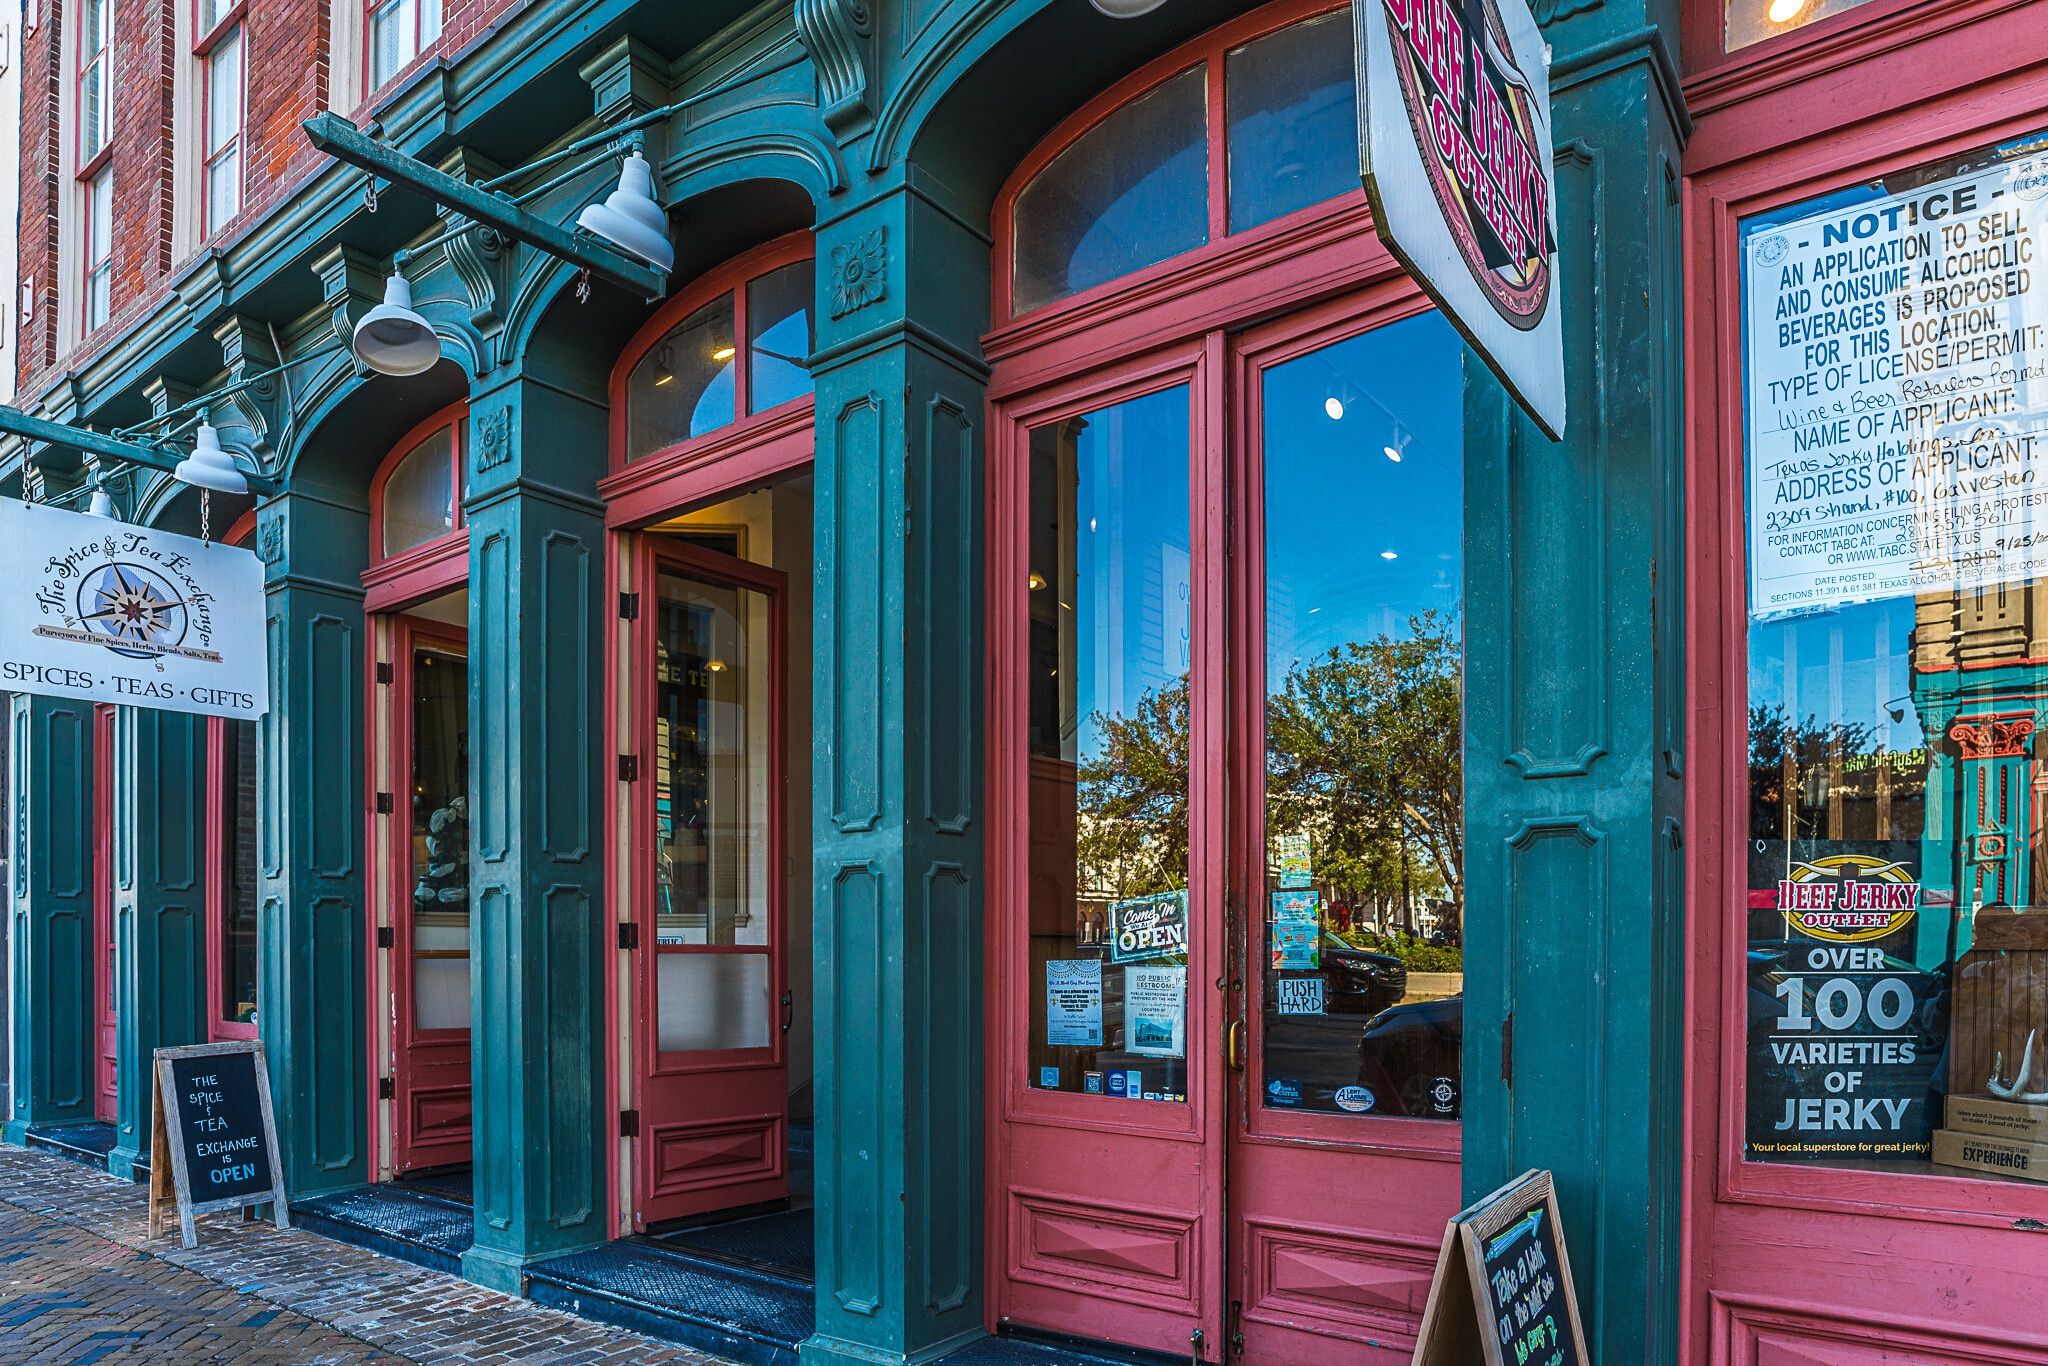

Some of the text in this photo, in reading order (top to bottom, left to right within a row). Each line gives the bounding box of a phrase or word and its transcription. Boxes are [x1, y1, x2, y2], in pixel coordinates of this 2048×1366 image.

[1470, 37, 1547, 265] JERKY
[1432, 93, 1526, 276] OUTLET
[1823, 184, 1977, 248] NOTICE
[1780, 208, 2027, 290] AN APPLICATION TO SELL
[1775, 237, 2033, 320] AND CONSUME ALCOHOLIC
[1779, 268, 2031, 348] BEVERAGES IS PROPOSED
[1805, 306, 2000, 370] FOR THIS LOCATION.
[1768, 325, 2044, 404] TYPE OF LICENSE/PERMIT:
[1778, 409, 1827, 431] Wine
[1850, 390, 1896, 413] Beer
[1793, 387, 2016, 453] NAME OF APPLICANT:
[1764, 457, 1821, 479] Texas
[1823, 448, 1873, 472] Jerky
[1775, 435, 2039, 504] ADDRESS OF APPLICANT:
[1766, 506, 1811, 531] 2309
[1933, 468, 2035, 500] Galveston
[1768, 492, 2048, 547] FOR INFORMATION CONCERNING FILING A PROTEST
[44, 542, 100, 579] Spice
[122, 532, 163, 561] Tea
[1779, 535, 1875, 558] CONTACT TABC AT:
[1827, 531, 1981, 565] OR WWW.TABC.STATE.TX.US
[1770, 558, 2047, 603] SECTIONS 11.391 & 61.381 TEXAS ALCOHOLIC BEVERAGE CODE
[1815, 572, 1877, 586] DATE POSTED:
[36, 580, 66, 614] The
[161, 551, 216, 643] Exchange
[39, 627, 78, 641] Purveyors
[79, 633, 88, 641] of
[88, 635, 105, 645] Fine
[106, 638, 131, 649] Spices,
[132, 641, 156, 652] Herbs,
[157, 645, 183, 657] Blends,
[3, 662, 254, 709] SPICES TEAS GIFTS
[1778, 880, 1920, 911] BEEF JERKY
[1123, 903, 1176, 925] Come In
[1802, 912, 1891, 928] OUTLET
[1119, 924, 1182, 951] OPEN
[1807, 948, 1885, 971] OVER
[1283, 980, 1317, 997] PUSH
[1775, 977, 1915, 1031] 100
[1280, 997, 1321, 1012] HARD
[1771, 1042, 1916, 1066] VARIETIES
[192, 1075, 218, 1087] THE
[1824, 1071, 1862, 1094] OF
[189, 1091, 224, 1106] SPICE
[194, 1117, 228, 1132] TEA
[1775, 1098, 1911, 1131] JERKY
[1988, 1120, 2006, 1128] pound
[1993, 1114, 2014, 1122] pounds
[196, 1136, 258, 1157] EXCHANGE
[222, 1154, 232, 1164] IS
[1752, 1142, 1930, 1154] Your local superstore for great jerky!
[1963, 1147, 2028, 1170] EXPERIENCE
[210, 1163, 255, 1184] OPEN
[1491, 1266, 1519, 1309] Take
[1517, 1257, 1528, 1283] a
[1499, 1313, 1514, 1345] on
[1514, 1301, 1529, 1329] the
